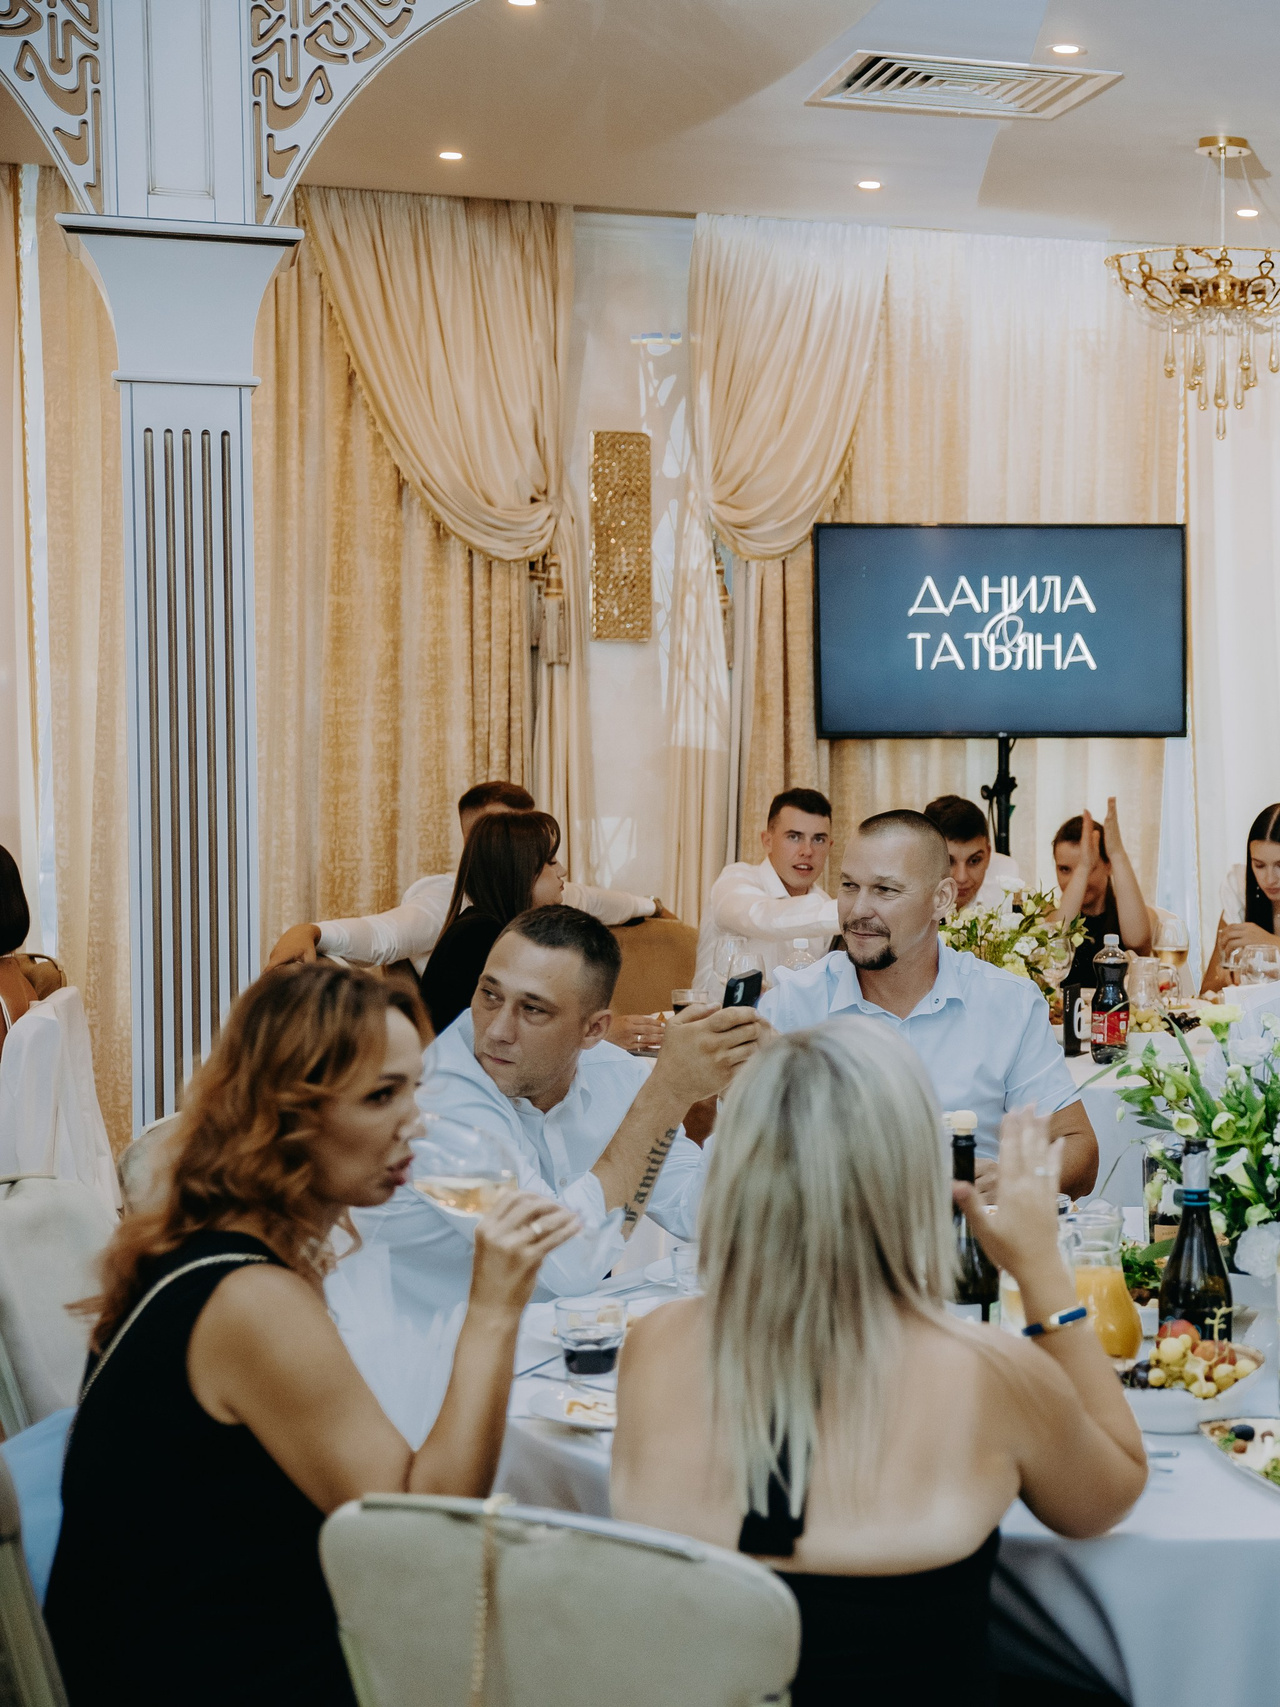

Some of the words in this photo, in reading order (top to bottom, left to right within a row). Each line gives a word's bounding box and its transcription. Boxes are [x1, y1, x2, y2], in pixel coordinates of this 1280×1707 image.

[907, 575, 1096, 616] ДАНИЛА
[907, 632, 1097, 671] ТАТЬЯНА
[1074, 998, 1087, 1039] 6
